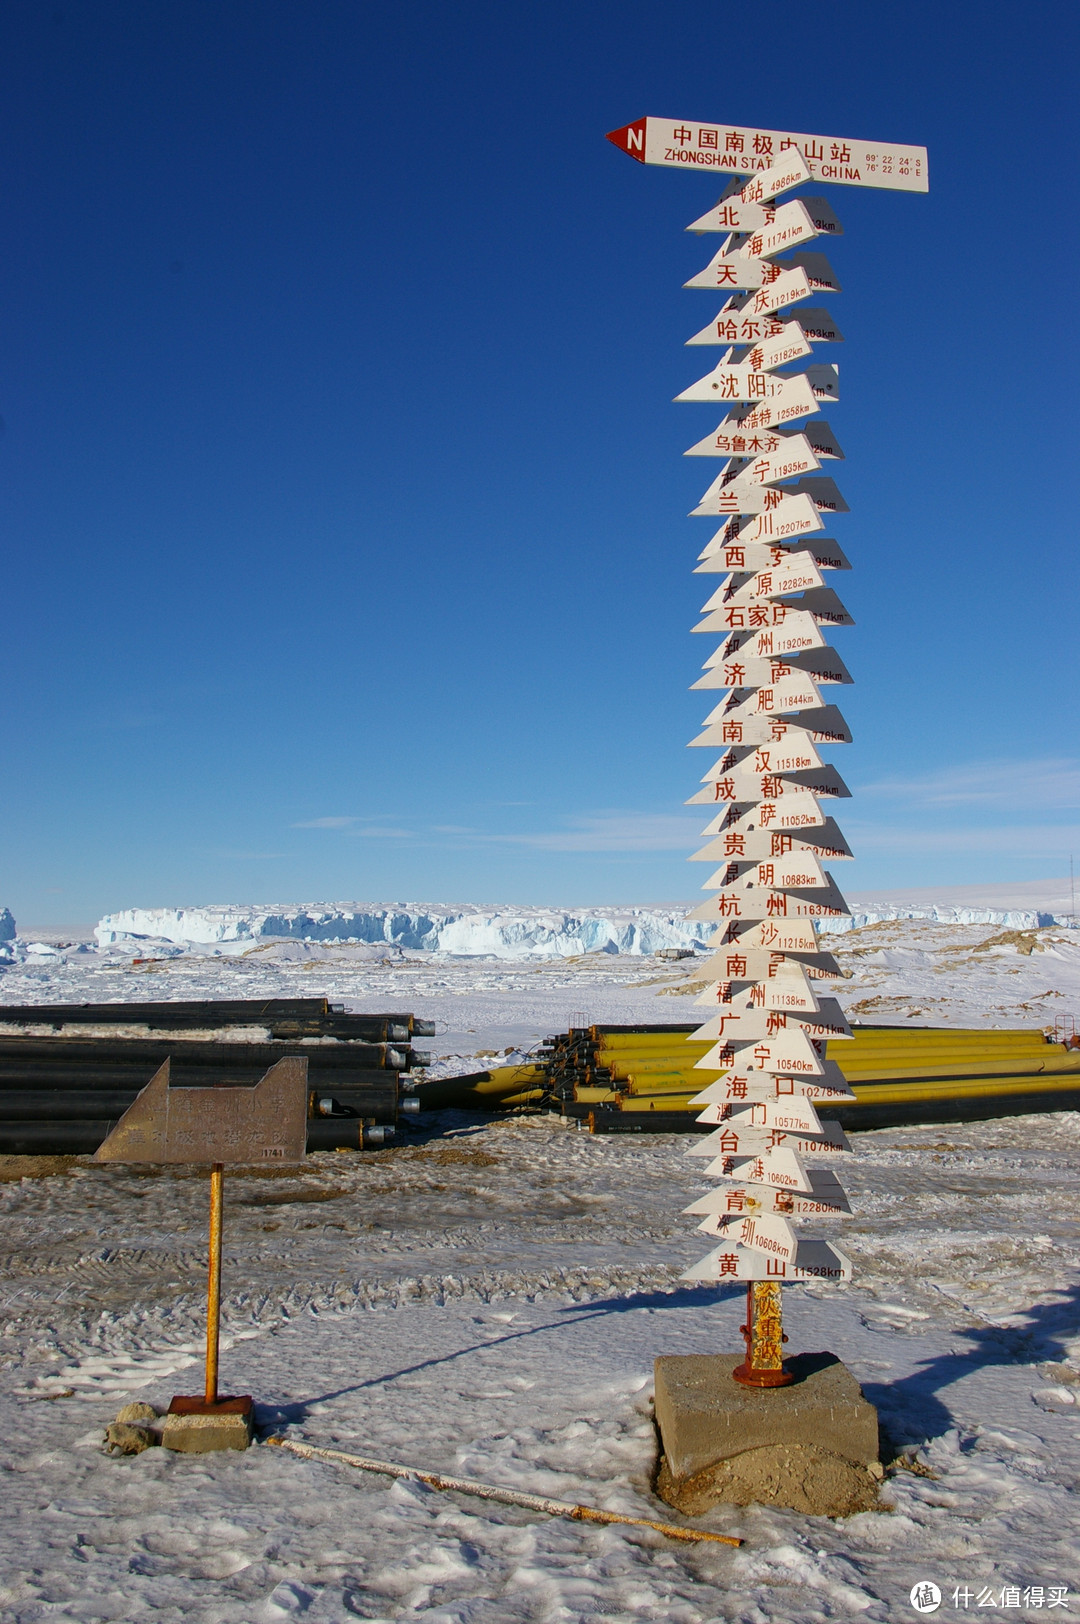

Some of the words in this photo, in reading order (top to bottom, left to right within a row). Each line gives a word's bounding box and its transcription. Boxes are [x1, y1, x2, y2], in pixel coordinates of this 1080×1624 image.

[626, 128, 643, 151] N
[673, 125, 851, 164] 中国南极中山站
[664, 148, 737, 168] ZHONGSHAN
[741, 156, 773, 171] STAT
[821, 165, 861, 181] CHINA
[915, 159, 921, 167] S
[915, 168, 921, 177] E
[770, 171, 801, 192] 4986km
[719, 206, 776, 227] 北京
[767, 225, 803, 248] 11741km
[717, 264, 781, 286] 天津
[770, 287, 807, 309] 11219km
[717, 318, 784, 341] 哈尔滨
[769, 347, 803, 365] 13182km
[720, 373, 766, 398] 沈阳
[776, 404, 810, 421] 12558km
[715, 434, 781, 453] 乌鲁木齐
[774, 461, 808, 478] 11935km
[719, 490, 783, 513] 兰州
[724, 514, 773, 541] 银川
[776, 519, 811, 536] 12207km
[723, 545, 791, 568] 西安
[778, 576, 814, 591] 12282km
[724, 604, 792, 627] 石家庄
[777, 637, 812, 651] 11920km
[723, 661, 791, 686] 济南
[779, 694, 814, 708] 11844km
[722, 719, 790, 743] 南京
[776, 757, 811, 770] 11518km
[714, 775, 784, 801] 成都
[781, 814, 816, 827] 11052km
[723, 832, 792, 857] 贵阳
[726, 864, 774, 886] 昆明
[781, 874, 817, 886] 10683km
[718, 893, 787, 917] 杭州
[796, 905, 842, 917] 11637km
[726, 922, 779, 946] 长沙
[778, 937, 815, 950] 11215km
[716, 981, 766, 1007] 福州
[771, 994, 806, 1007] 11138km
[719, 1012, 787, 1036] 广州
[719, 1043, 771, 1070] 南宁
[776, 1059, 813, 1072] 10540km
[726, 1075, 795, 1100] 海口
[801, 1086, 847, 1098] 10278km
[717, 1103, 766, 1126] 澳门
[774, 1117, 810, 1130] 10577km
[719, 1128, 787, 1153] 台北
[798, 1141, 843, 1153] 11078km
[721, 1155, 764, 1182] 香港
[767, 1172, 798, 1187] 10602km
[725, 1189, 794, 1214] 青岛
[797, 1203, 841, 1213] 12280km
[755, 1234, 789, 1258] 10608km
[718, 1253, 786, 1278] 黄山
[793, 1267, 845, 1278] 11528km
